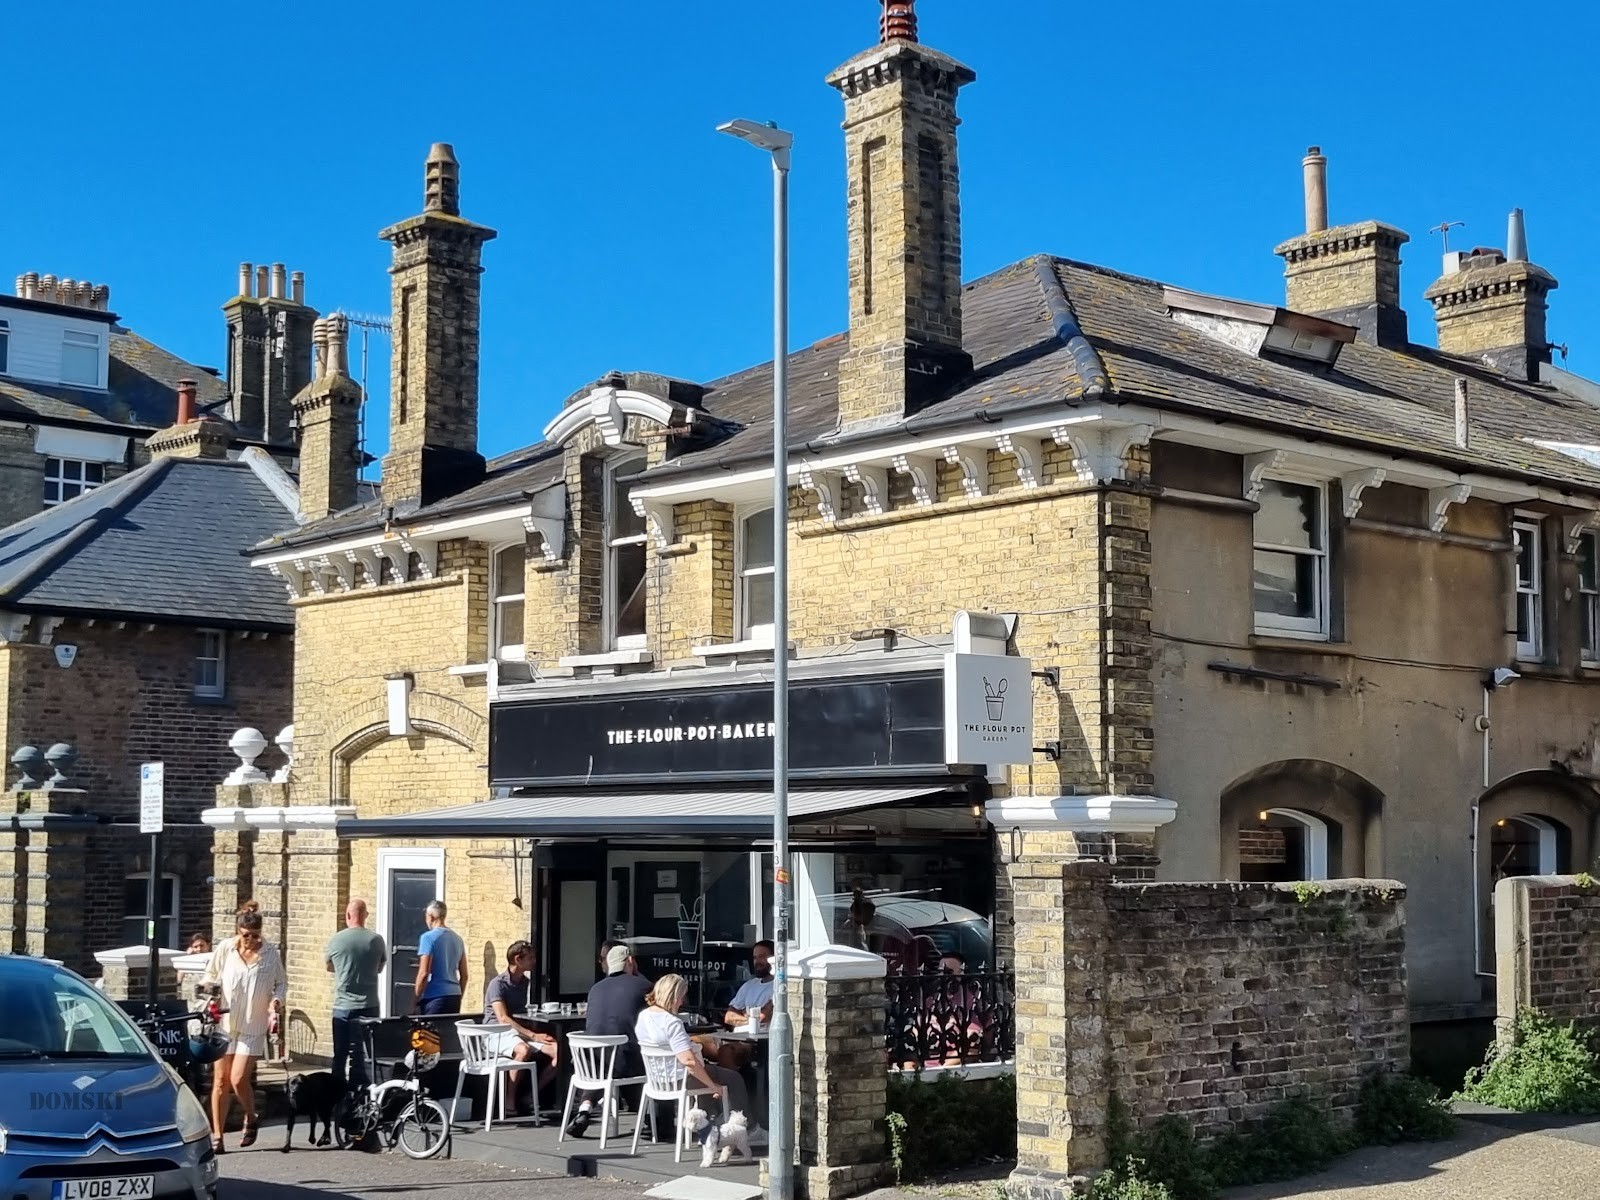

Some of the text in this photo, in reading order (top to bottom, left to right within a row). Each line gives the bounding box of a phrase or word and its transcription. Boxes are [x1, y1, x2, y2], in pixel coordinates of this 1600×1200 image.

[607, 722, 776, 745] THE FLOUR POT BAKER
[964, 724, 1026, 734] THE FLOUR POT
[652, 957, 727, 971] THE FLOUR POT
[65, 1177, 151, 1200] LV08 ZXX
